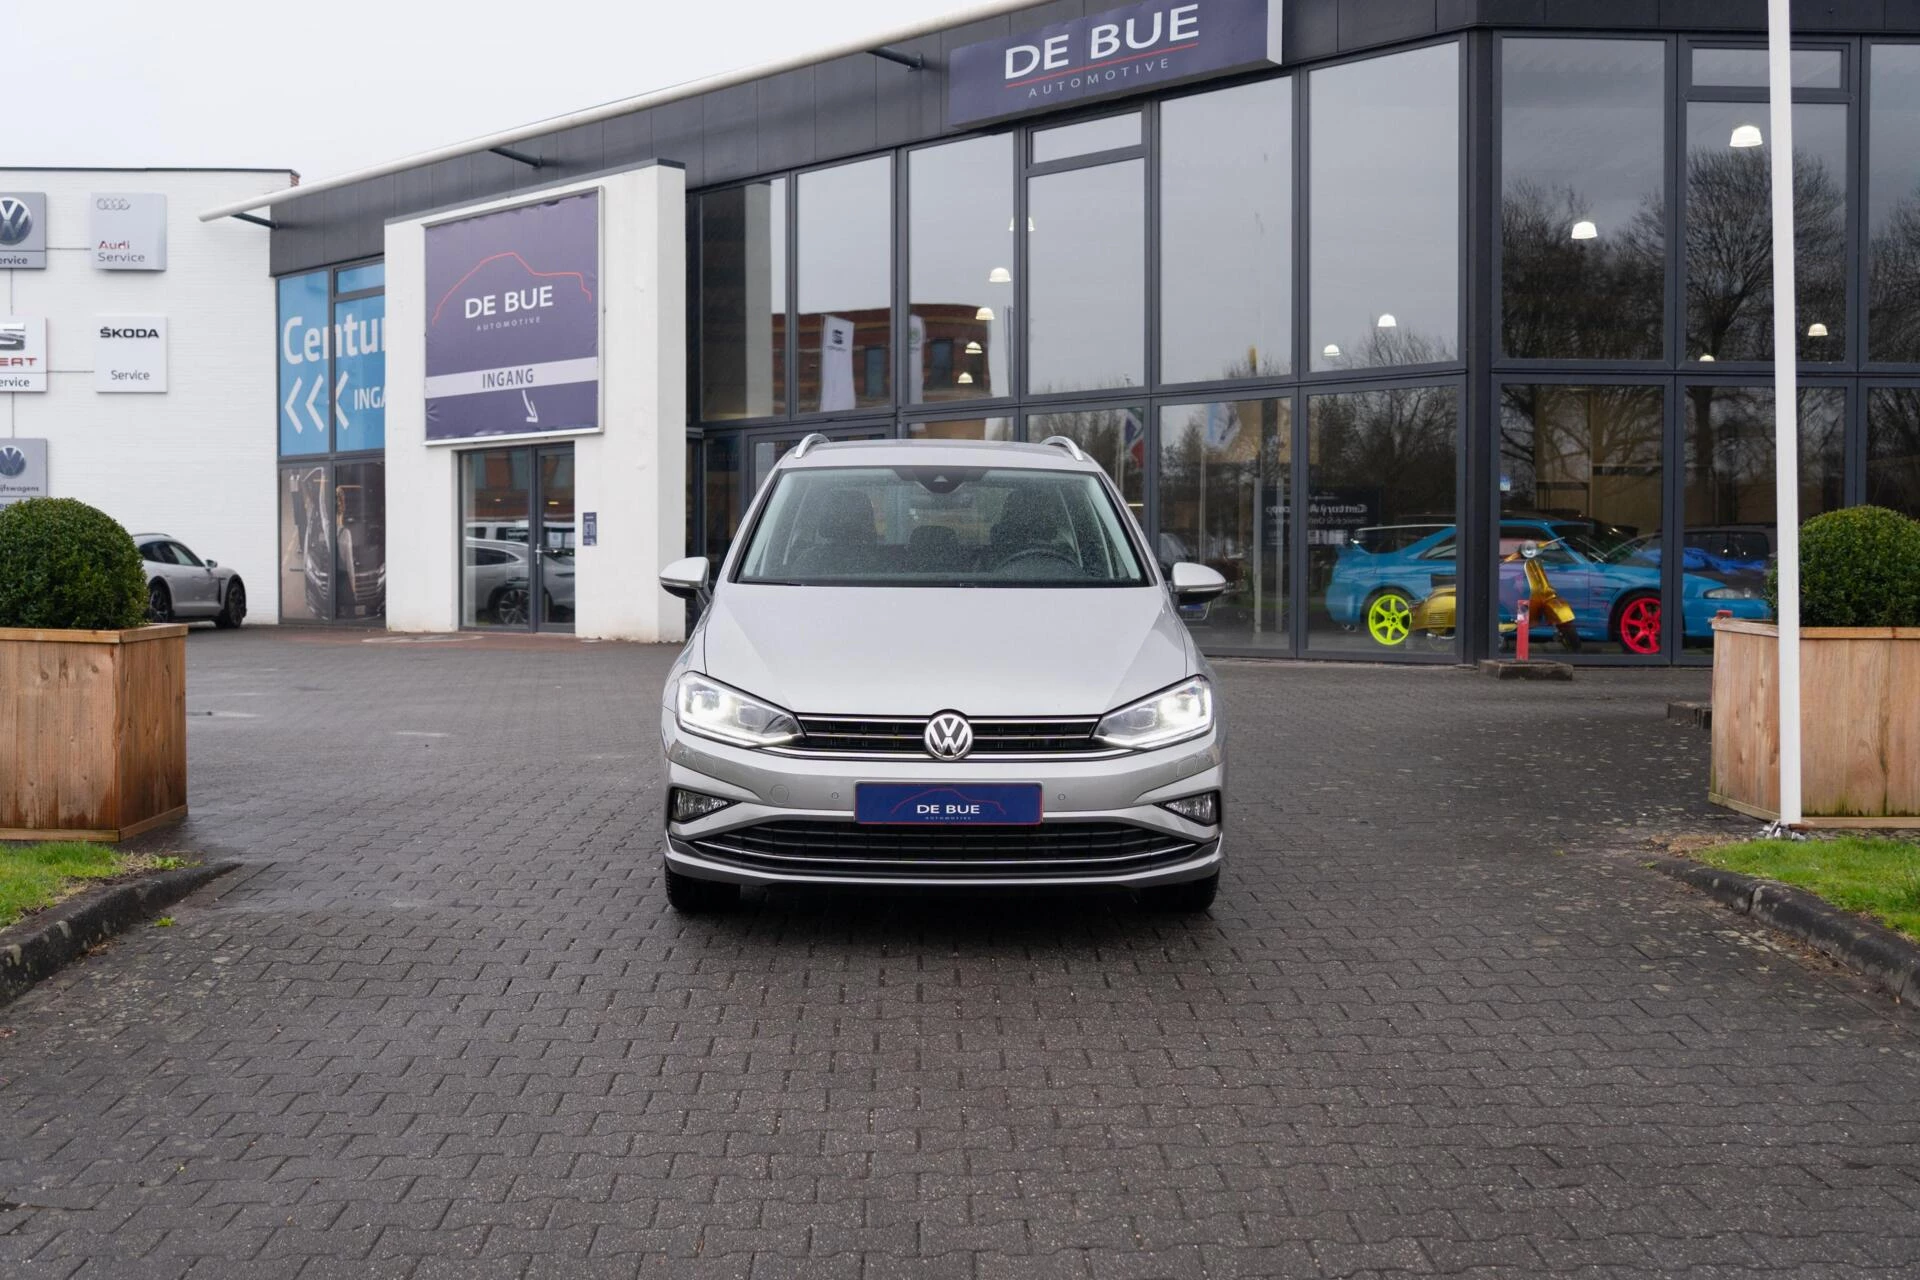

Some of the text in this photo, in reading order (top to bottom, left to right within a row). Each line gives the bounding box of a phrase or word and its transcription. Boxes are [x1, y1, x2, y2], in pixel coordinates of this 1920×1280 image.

[1005, 4, 1199, 80] DE BUE
[1028, 58, 1168, 98] AUTOMOTIVE
[98, 240, 130, 250] Audi
[0, 256, 28, 265] rvice
[98, 252, 145, 263] Service
[465, 285, 553, 319] DE BUE
[476, 316, 541, 331] AUTOMOTIVE
[100, 326, 159, 339] ŠKODA
[283, 313, 385, 365] Centu
[0, 357, 38, 367] EAT
[111, 369, 150, 381] Service
[482, 368, 534, 389] INGANG
[0, 376, 30, 387] ervice
[916, 804, 981, 814] DE BUE
